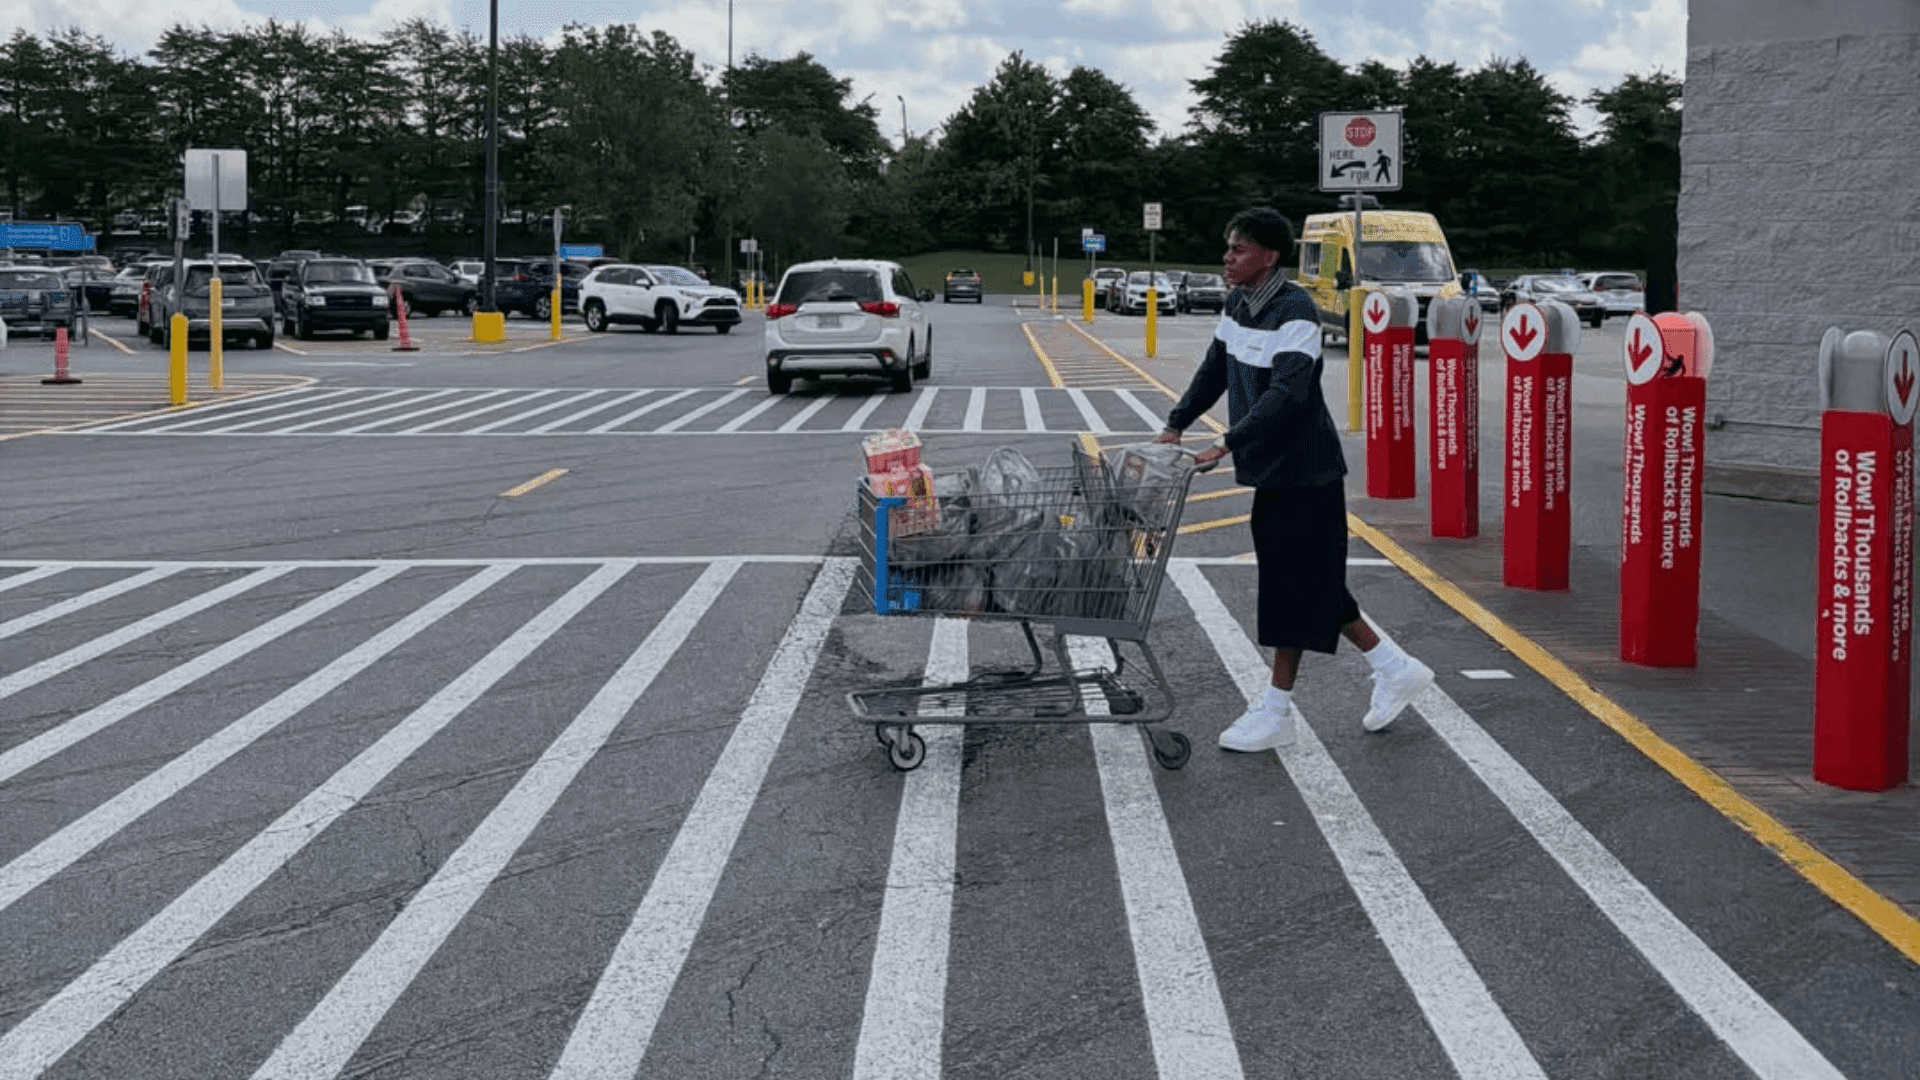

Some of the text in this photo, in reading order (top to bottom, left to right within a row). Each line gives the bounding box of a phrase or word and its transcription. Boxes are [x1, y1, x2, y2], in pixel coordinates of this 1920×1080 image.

[1329, 149, 1355, 160] HERE
[1347, 126, 1374, 139] STOP
[1350, 170, 1370, 182] FOR
[1436, 358, 1446, 370] of
[1447, 358, 1458, 455] Wow! Thousands
[1546, 377, 1556, 391] of
[1438, 439, 1446, 469] more
[1512, 376, 1522, 508] of Rollbacks & more
[1522, 376, 1533, 491] Wow! Thousands
[1556, 377, 1567, 492] Wow! Thousands
[1630, 404, 1646, 544] Wow! Thousands
[1679, 406, 1696, 548] Wow! Thousands
[1545, 474, 1554, 510] more
[1661, 406, 1679, 569] of Rollbacks & more
[1832, 449, 1852, 661] of Rollbacks & more
[1854, 451, 1876, 635] Wow! Thousands
